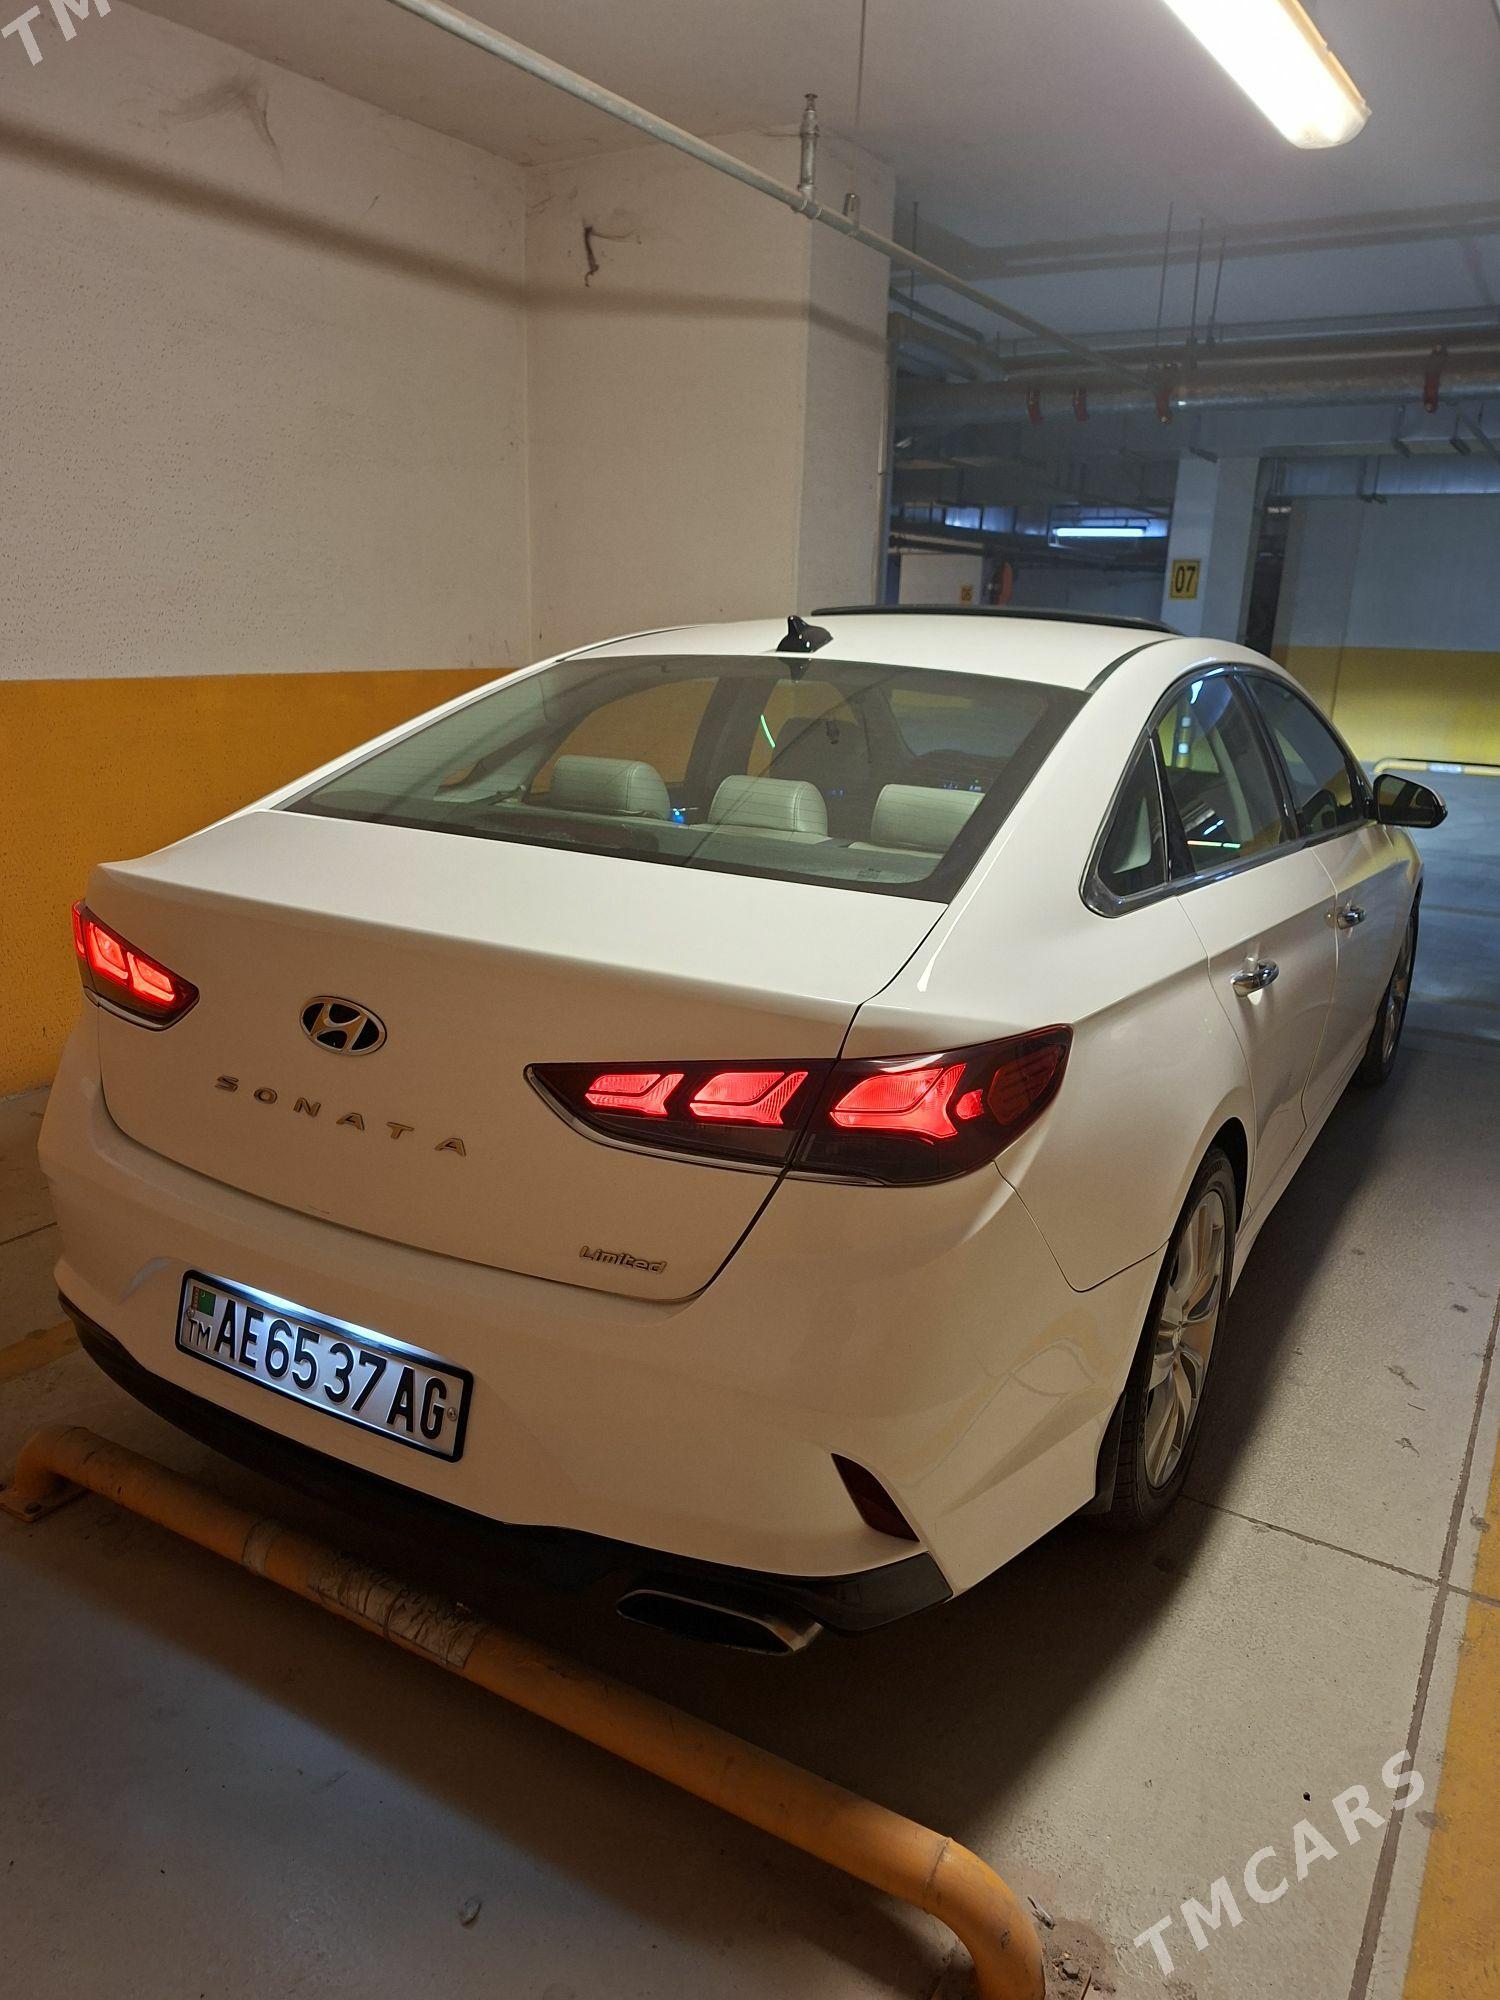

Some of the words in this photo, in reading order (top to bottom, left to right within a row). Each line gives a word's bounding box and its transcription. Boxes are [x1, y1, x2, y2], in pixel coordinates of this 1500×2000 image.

[1175, 566, 1196, 593] 07
[214, 1075, 467, 1157] SONATA
[579, 1245, 668, 1274] Limited
[188, 1318, 212, 1350] TM
